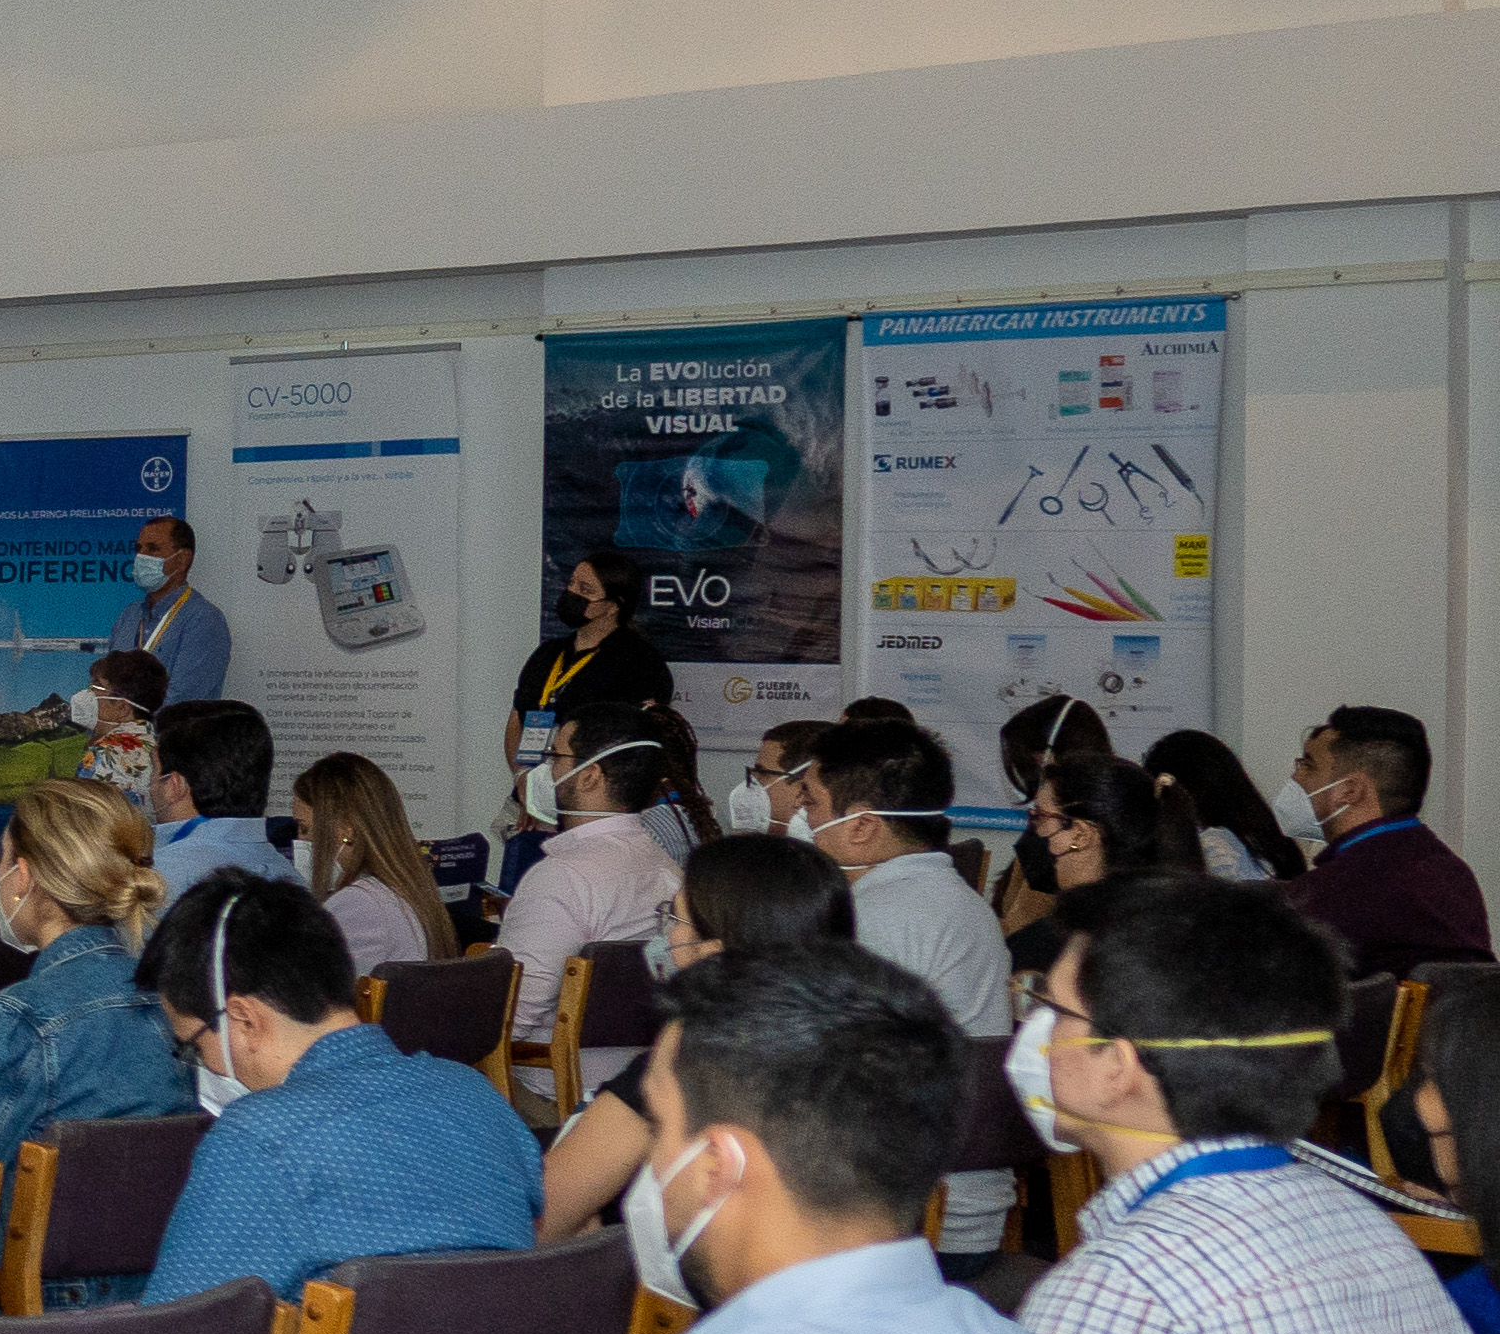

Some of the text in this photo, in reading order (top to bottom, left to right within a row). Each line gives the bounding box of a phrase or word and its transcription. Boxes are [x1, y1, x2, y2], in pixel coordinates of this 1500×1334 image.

[878, 303, 1207, 337] PANAMERICAN INSTRUMENTS
[617, 359, 771, 382] La EVOlución
[248, 382, 352, 408] CV-5000
[601, 385, 786, 409] de la LIBERTAD
[645, 413, 738, 434] VISUAL
[896, 455, 956, 469] RUMEX
[18, 510, 29, 519] LA
[31, 509, 68, 519] JERINGA
[70, 507, 128, 519] PRELLENADA
[131, 507, 144, 517] DE
[1177, 539, 1207, 552] MANI
[651, 568, 731, 607] EVO
[686, 615, 730, 629] Visian
[877, 635, 943, 650] JEDMED
[756, 681, 801, 691] GUERRA
[756, 691, 811, 701] & GUERRA
